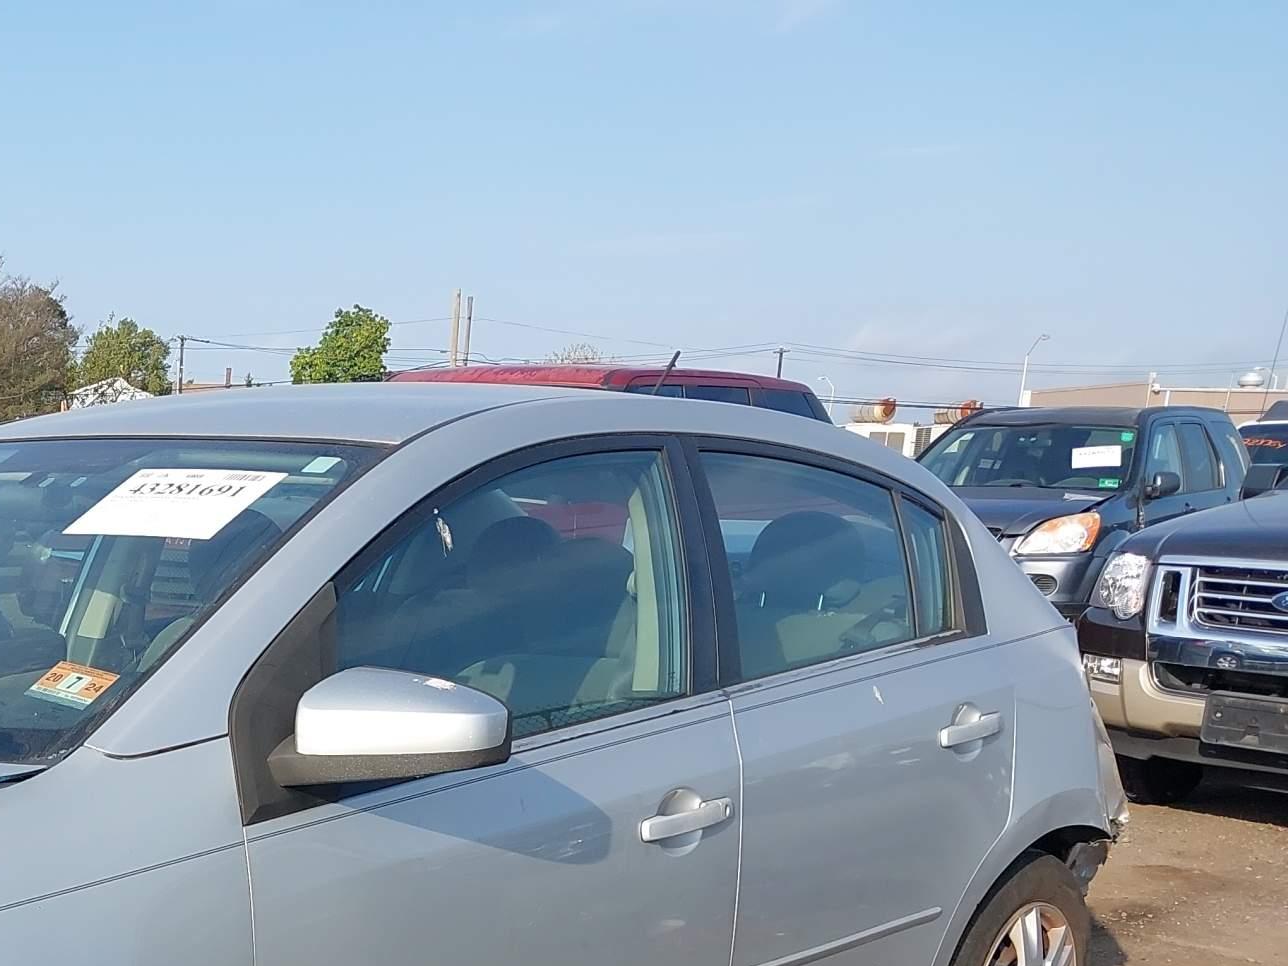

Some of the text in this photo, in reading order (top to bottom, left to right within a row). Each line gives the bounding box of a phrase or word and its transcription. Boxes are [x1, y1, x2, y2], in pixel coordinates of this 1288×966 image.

[128, 482, 245, 498] 43281691
[45, 672, 104, 694] 20 7 24
